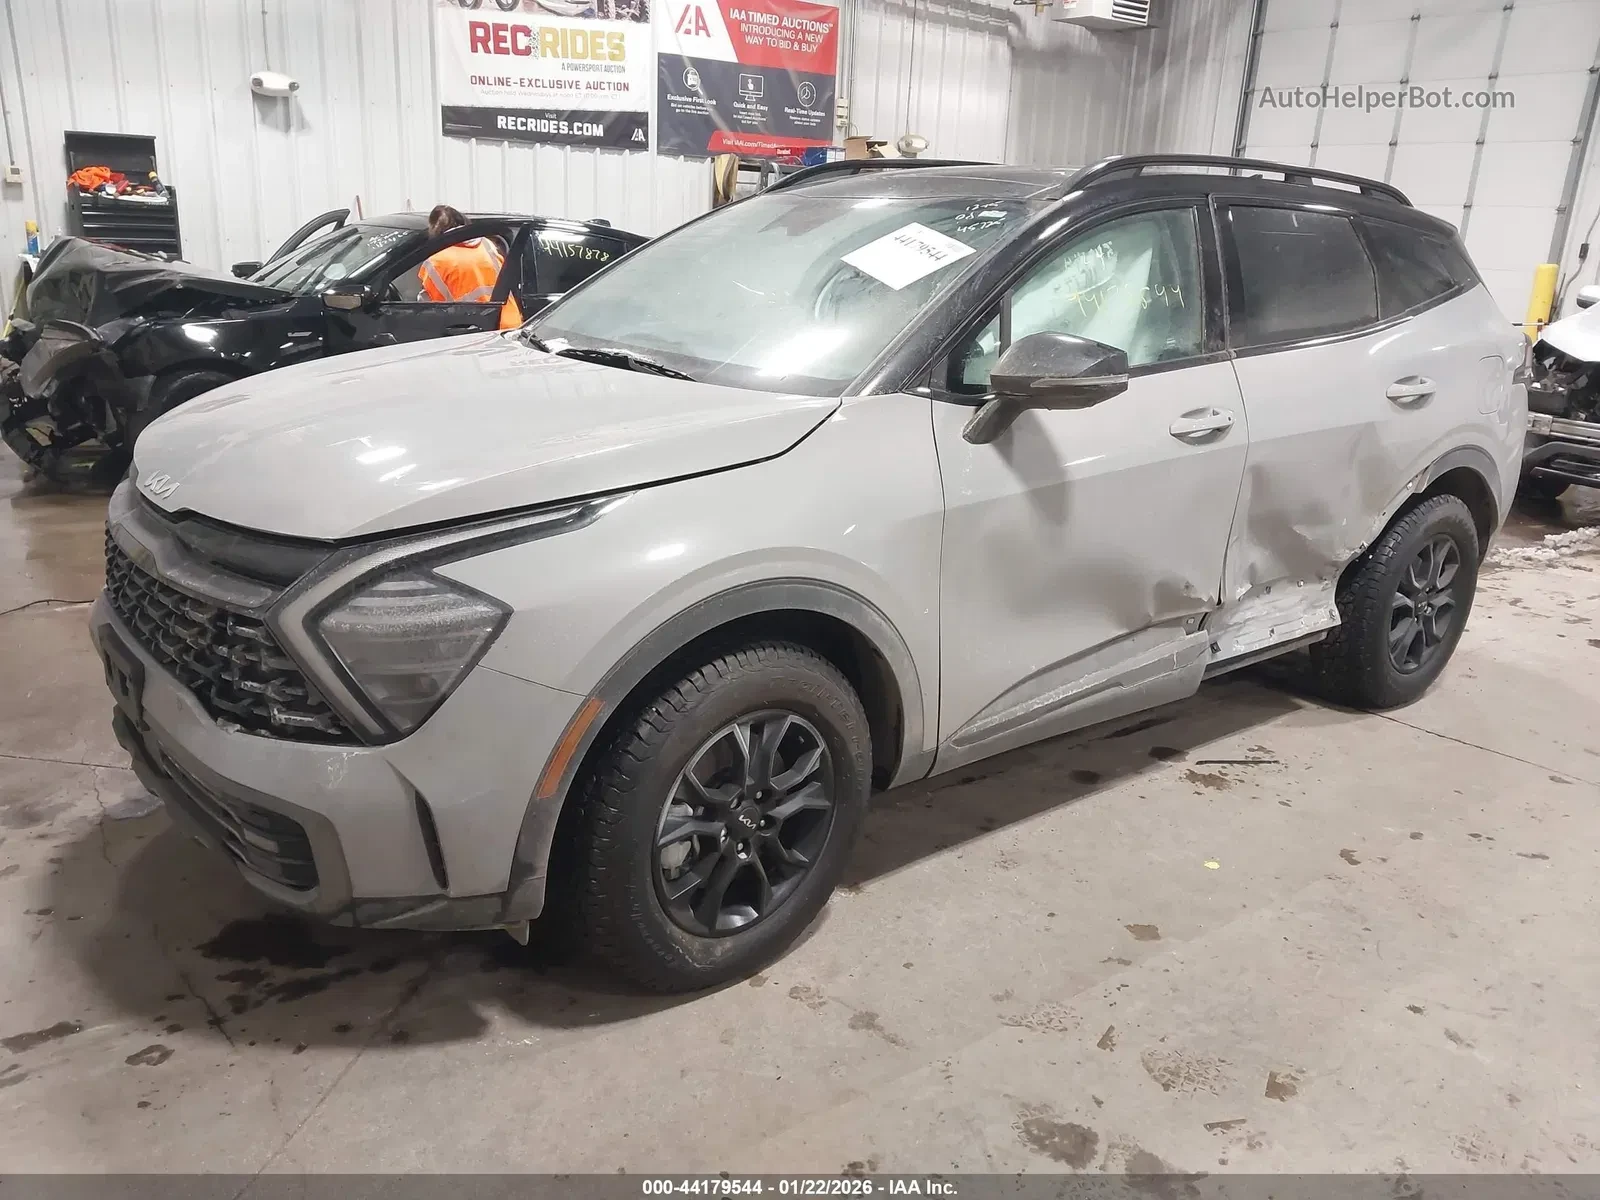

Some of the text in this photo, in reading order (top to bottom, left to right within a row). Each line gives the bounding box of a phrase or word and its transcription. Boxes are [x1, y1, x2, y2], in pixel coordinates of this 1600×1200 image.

[730, 8, 746, 19] IAA
[748, 11, 779, 25] TIMED
[740, 23, 824, 43] INTRODUCING A NEW
[469, 21, 626, 62] REC RIDES
[745, 35, 818, 53] WAY TO BID & BUY
[561, 62, 626, 74] A POWERSPORT AUCTION
[470, 75, 630, 91] ONLINE-EXCLUSIVE AUCTION
[667, 94, 692, 102] Exclusive
[757, 104, 768, 112] Easy
[784, 107, 826, 117] Real-Time Updates
[497, 115, 604, 137] RECRIDES.COM
